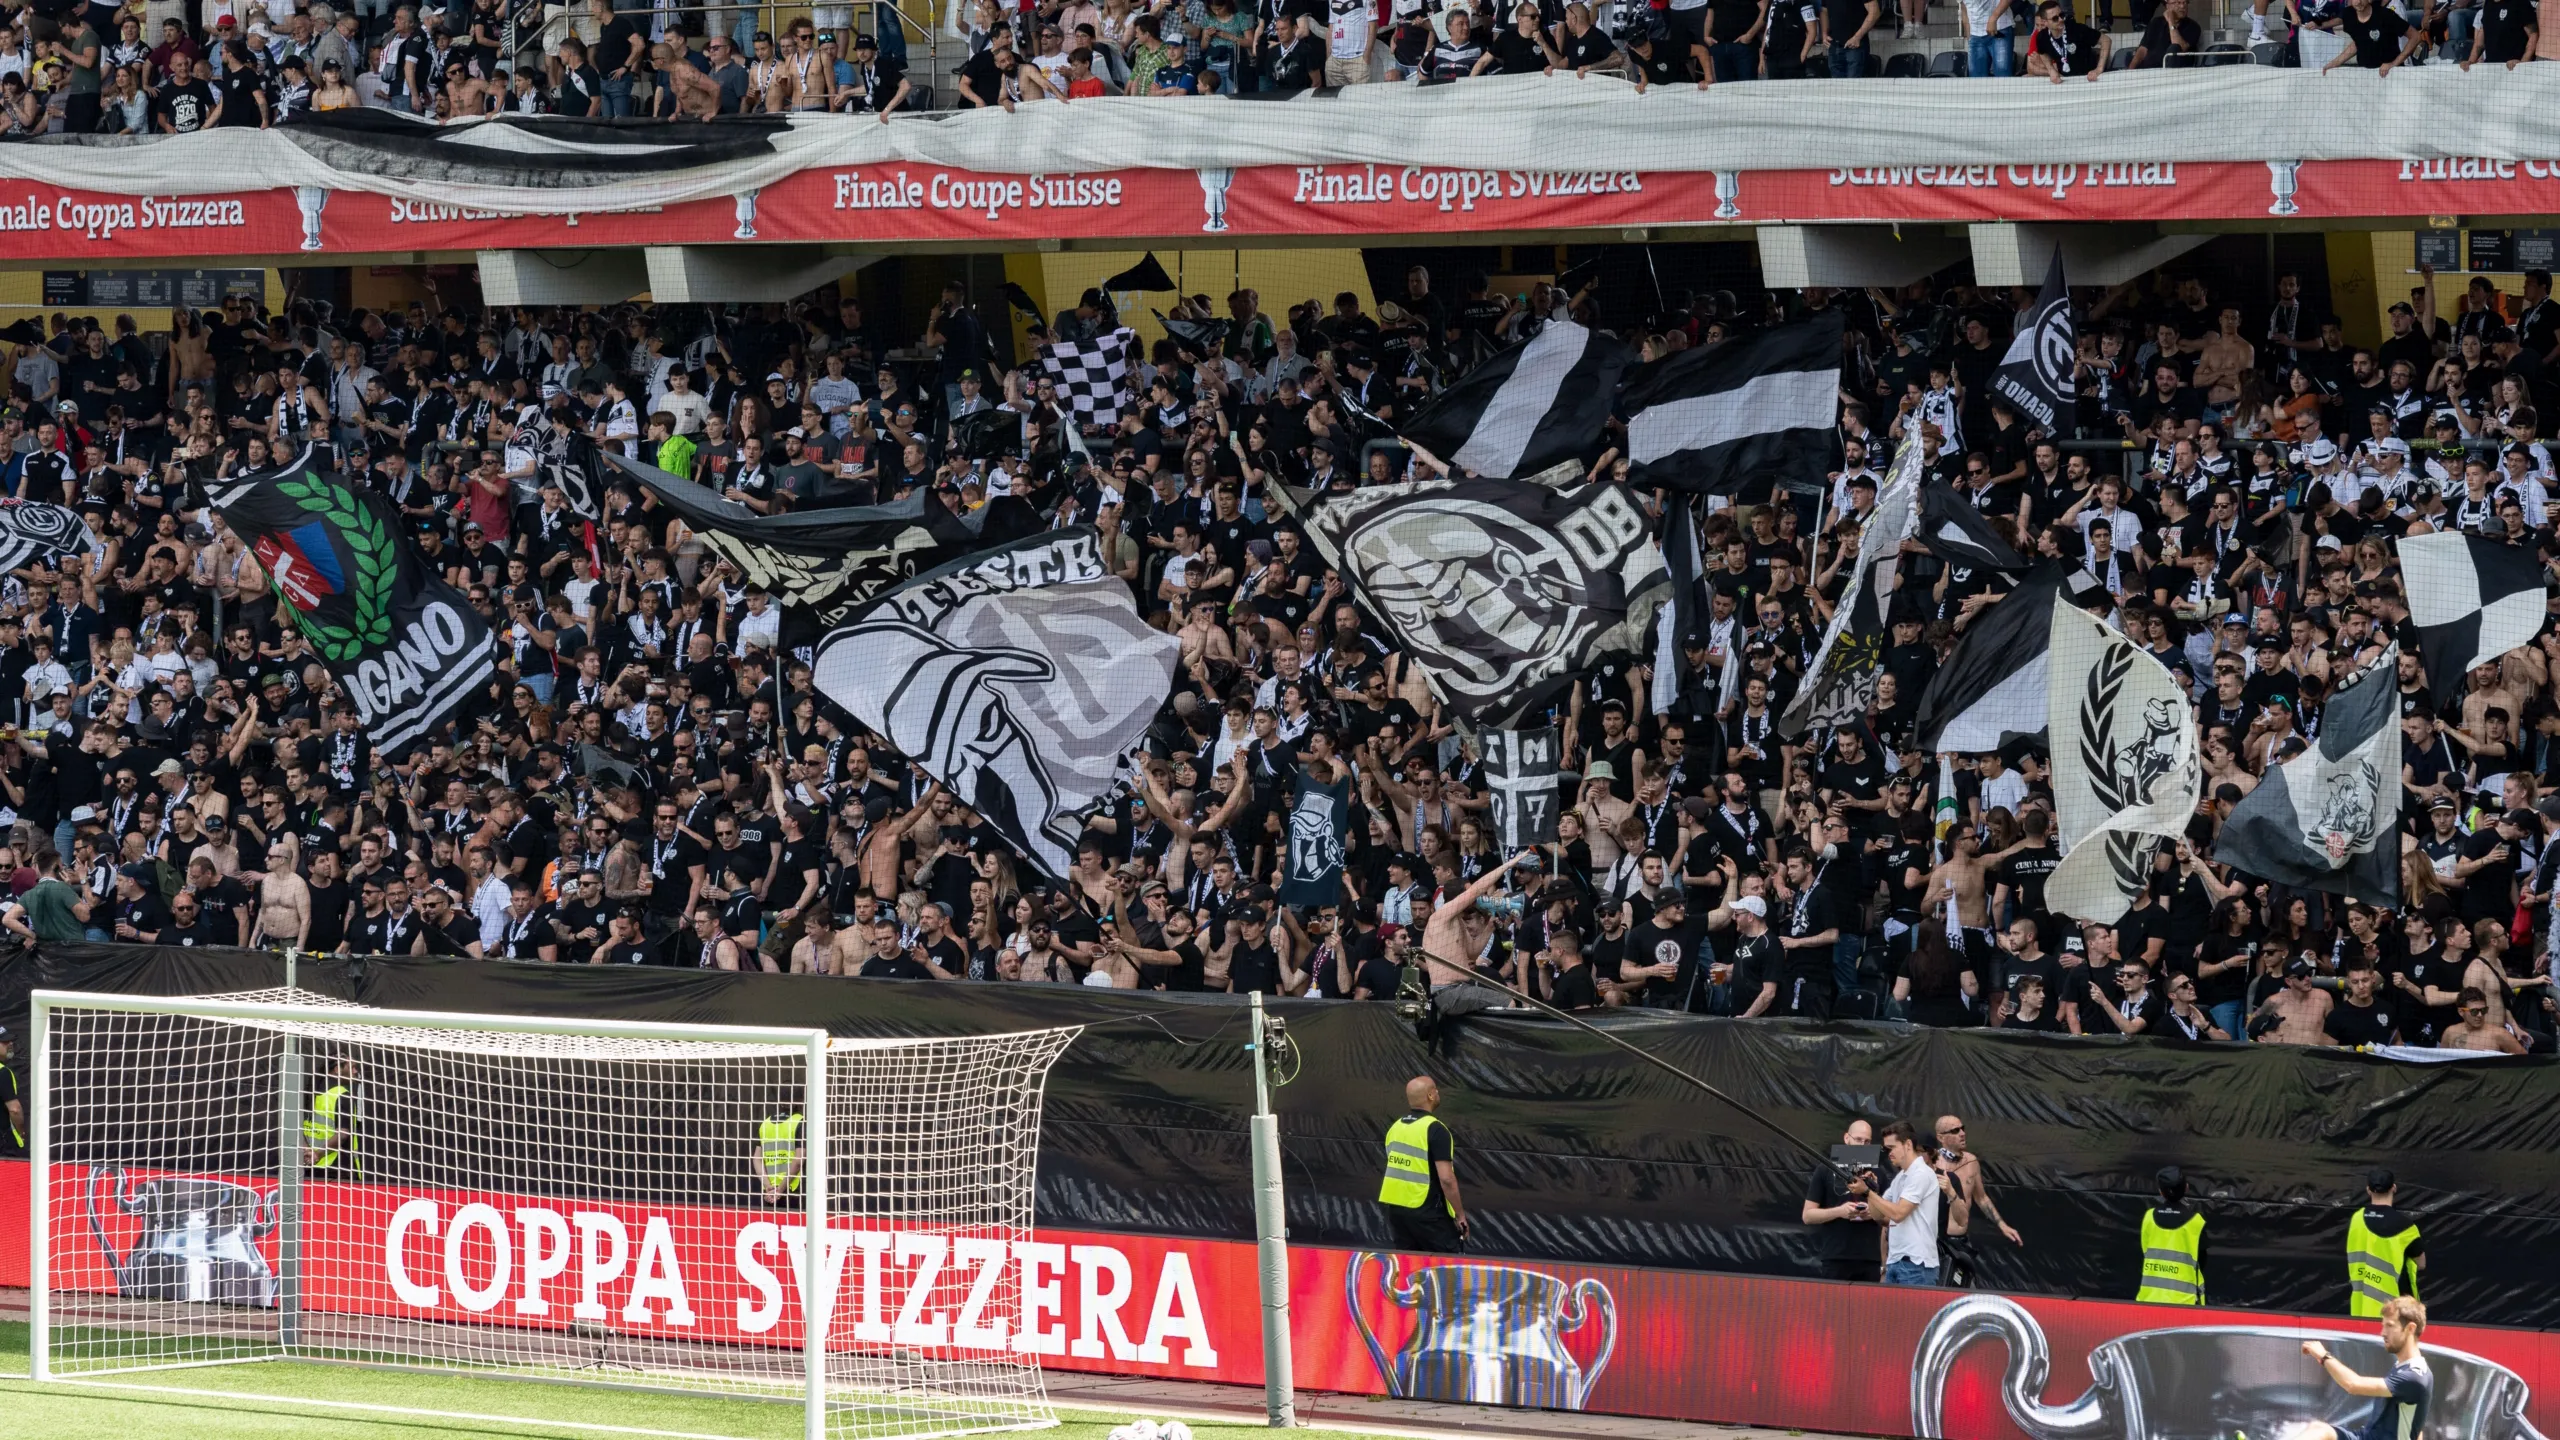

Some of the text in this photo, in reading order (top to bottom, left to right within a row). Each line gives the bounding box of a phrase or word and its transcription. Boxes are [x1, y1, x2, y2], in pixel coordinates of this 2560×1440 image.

[175, 103, 197, 118] 1970
[1293, 164, 1643, 211] Finale Coppa Svizzera
[2007, 163, 2077, 200] Cup
[2084, 161, 2175, 187] Final
[2398, 156, 2516, 181] Finale
[833, 171, 1122, 219] Finale Coupe Suisse
[56, 196, 136, 239] Coppa
[141, 194, 245, 229] Svizzera
[818, 393, 848, 405] LUGANO
[385, 1198, 1219, 1369] COPPA SVIZZERA
[2144, 1262, 2179, 1275] STEWARD
